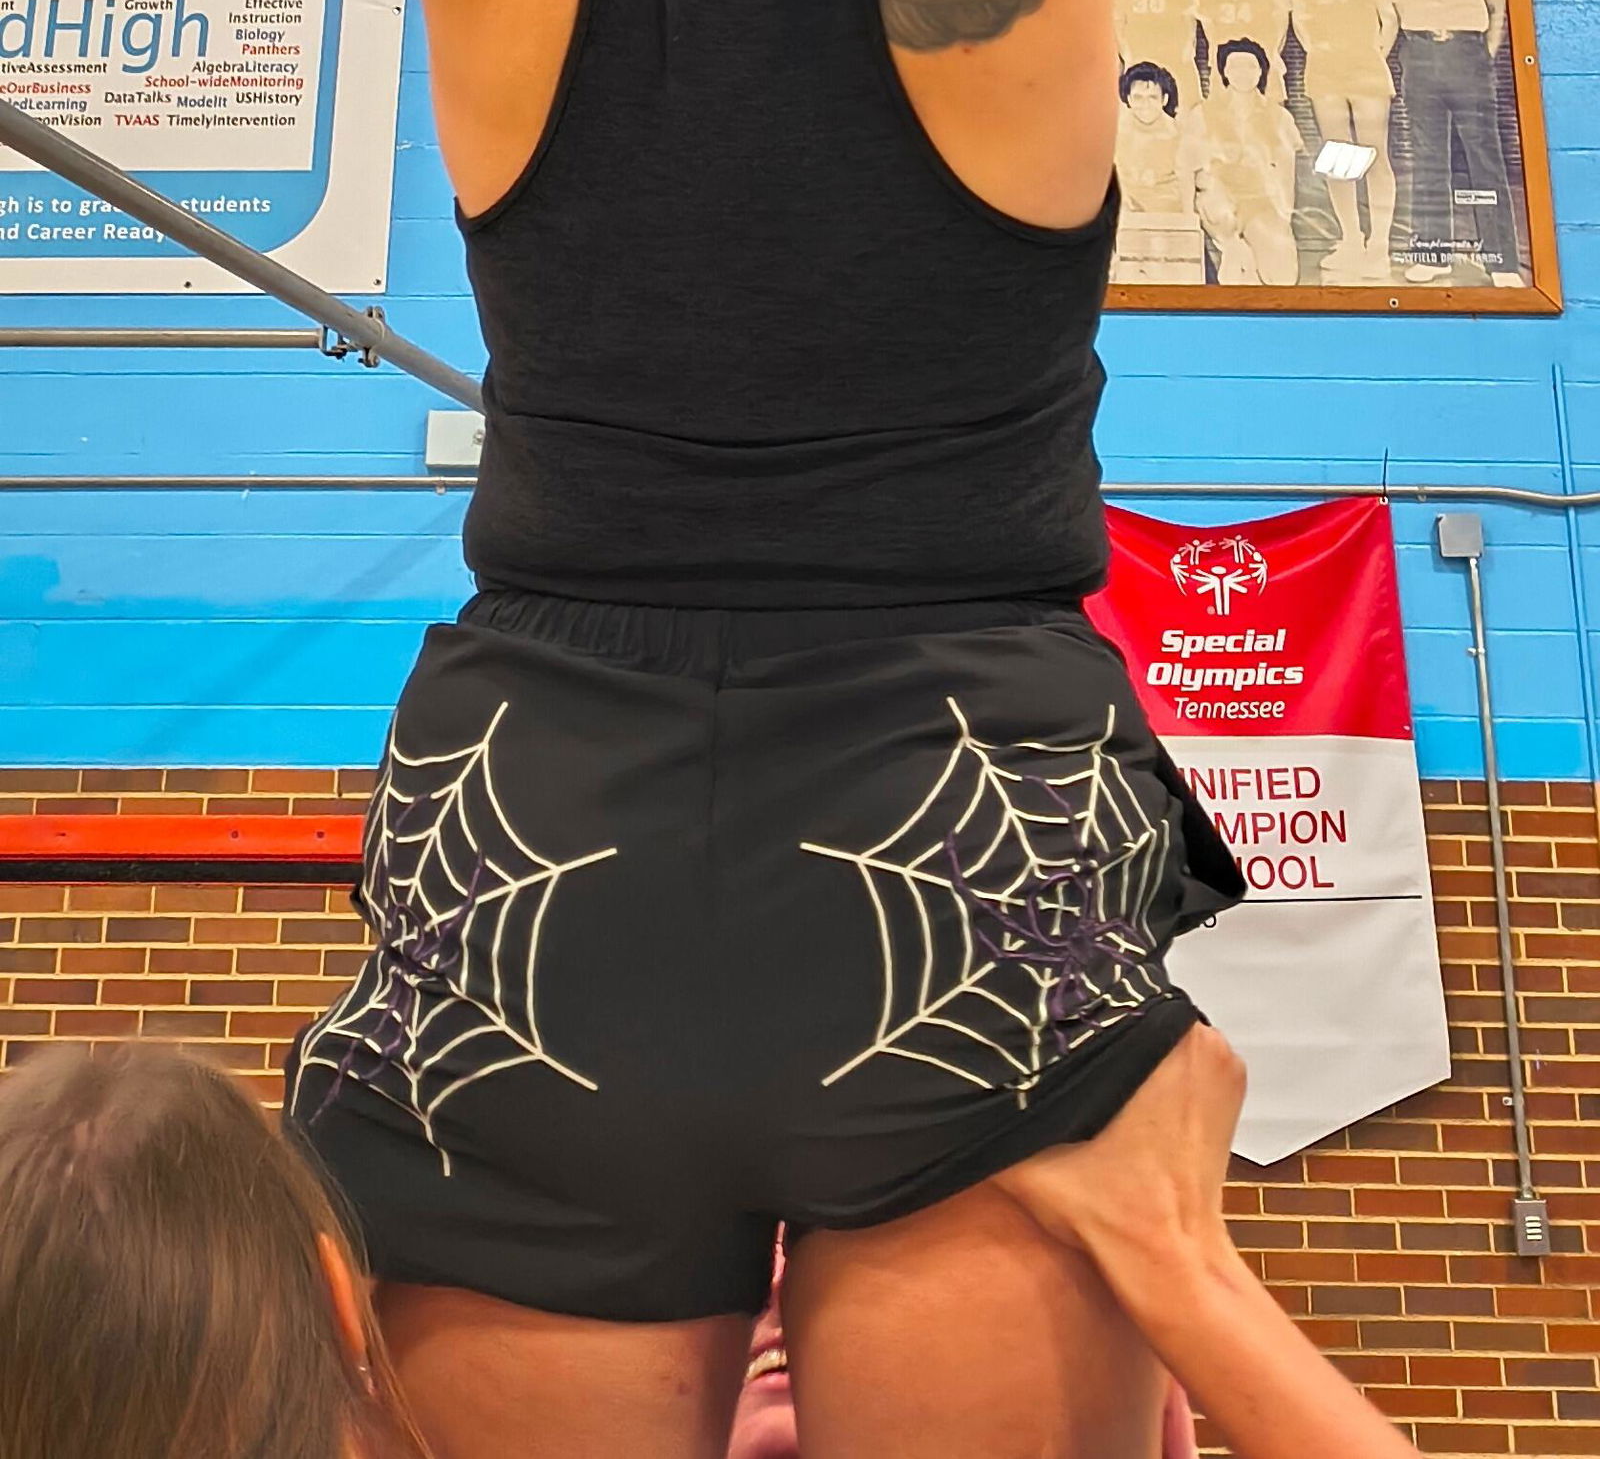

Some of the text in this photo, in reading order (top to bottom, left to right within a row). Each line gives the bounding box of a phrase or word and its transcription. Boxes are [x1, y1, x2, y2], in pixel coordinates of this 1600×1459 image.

[229, 12, 302, 24] Instruction
[235, 27, 285, 43] Biology
[242, 43, 301, 56] Panthers
[192, 60, 299, 76] AlgebraLiteracy
[144, 75, 304, 90] School-wideMonitoring
[8, 97, 88, 112] edLearning
[104, 91, 172, 104] DataTalks
[235, 91, 302, 107] USHistory
[37, 113, 297, 129] onVision TVAAS TimelyIntervention
[27, 196, 44, 214] is
[51, 197, 72, 214] to
[79, 199, 122, 217] gra
[180, 195, 272, 214] students
[27, 222, 97, 241] Career
[1161, 628, 1287, 659] Special
[1146, 661, 1305, 692] Olympics
[1173, 696, 1286, 720] Tennessee
[1213, 809, 1348, 845] MPION
[1236, 854, 1335, 890] OOL
